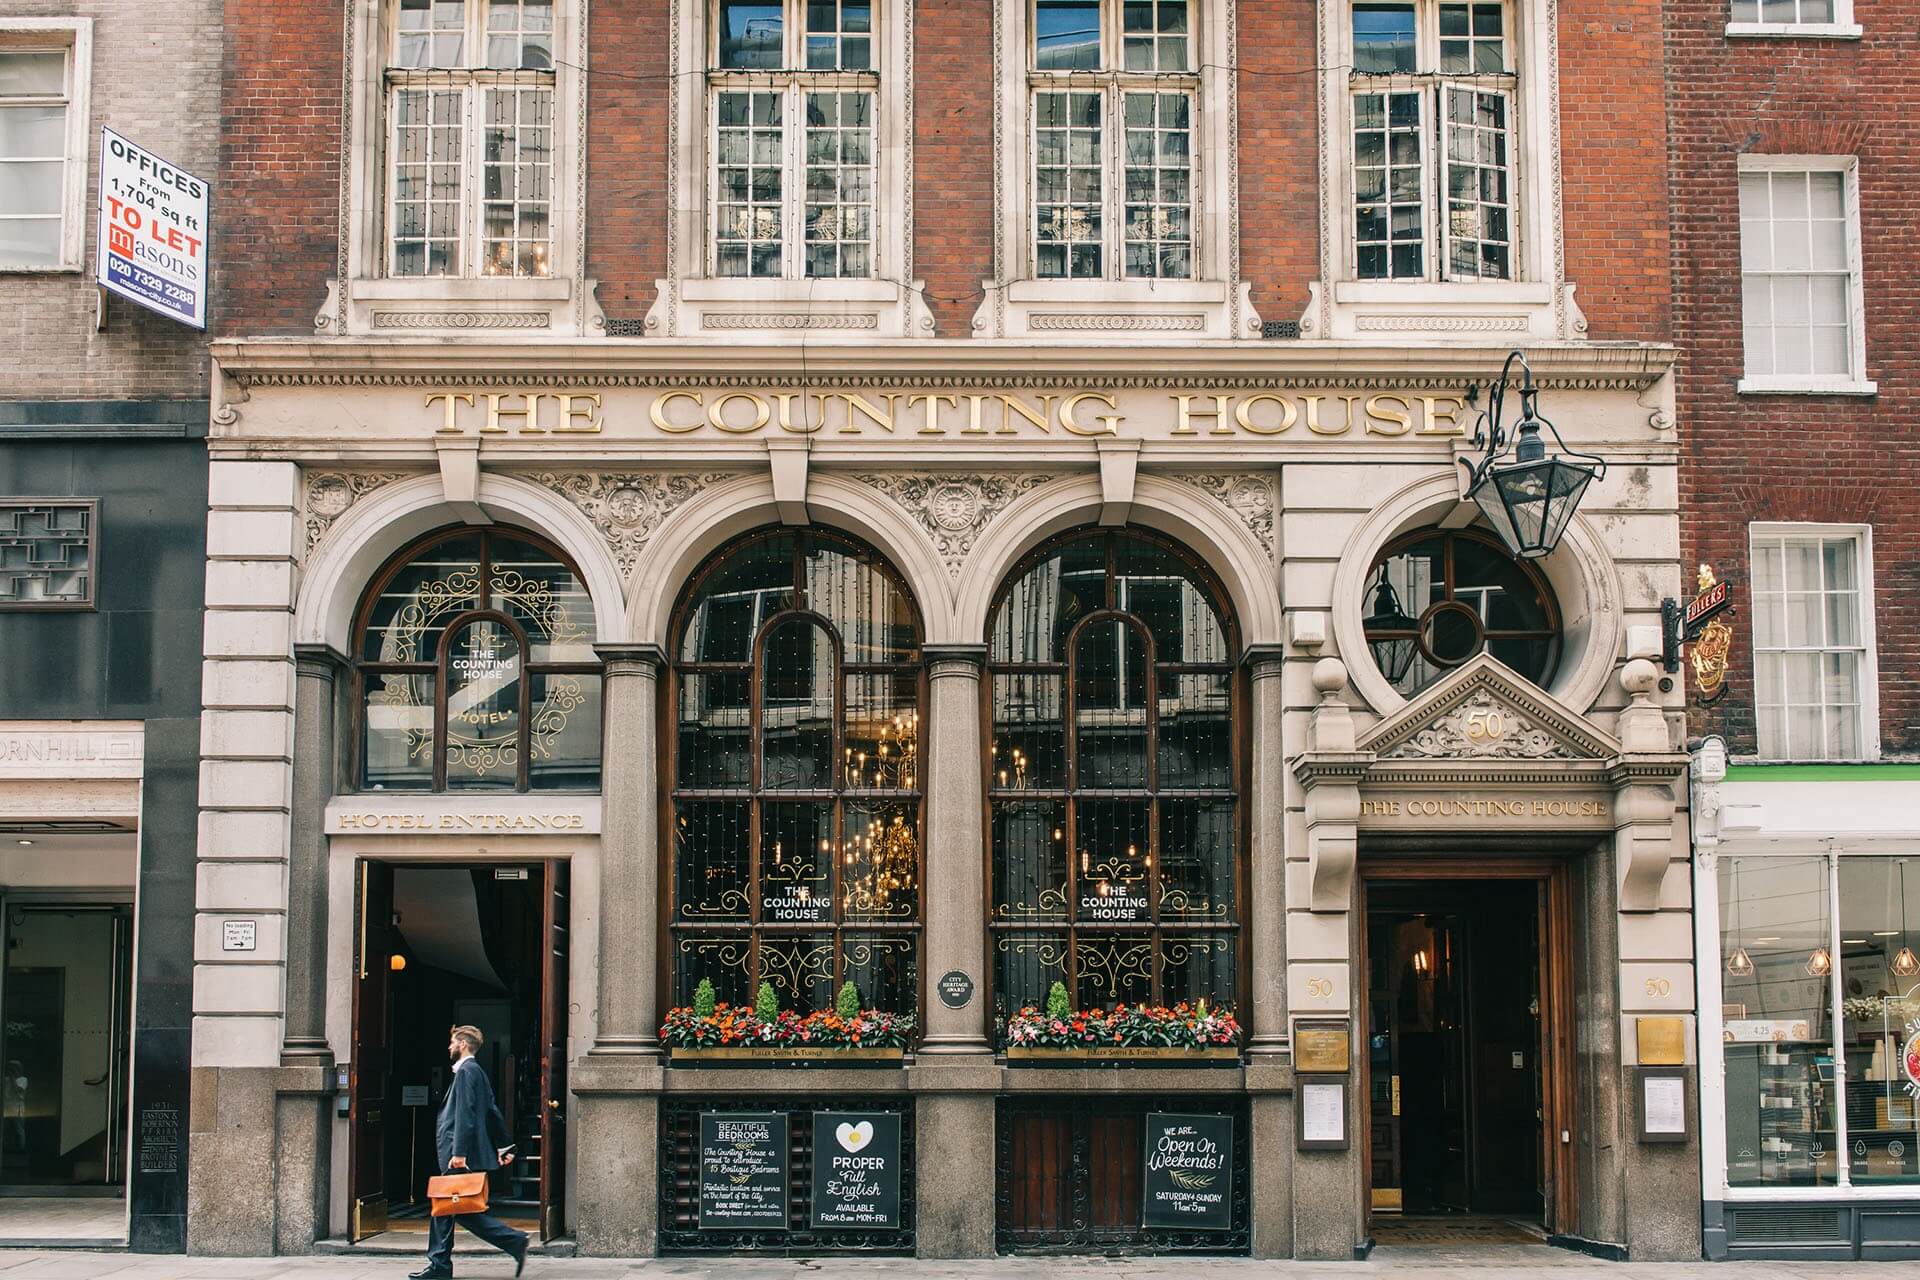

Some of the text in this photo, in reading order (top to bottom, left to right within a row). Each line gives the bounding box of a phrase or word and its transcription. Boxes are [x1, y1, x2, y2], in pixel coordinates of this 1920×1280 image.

[110, 139, 202, 199] OFFICES
[139, 178, 170, 201] From
[111, 178, 198, 231] 1,704 sq ft
[107, 196, 202, 258] TO LET
[109, 223, 197, 280] masons
[110, 257, 132, 277] 020
[134, 269, 162, 290] 7329
[165, 282, 194, 305] 2288
[425, 390, 1468, 437] THE COUNTING HOUSE
[472, 650, 494, 659] THE
[452, 660, 514, 669] COUNTING
[464, 670, 502, 679] HOUSE
[458, 711, 508, 724] HOTEL
[1465, 711, 1504, 741] 50
[1360, 799, 1608, 817] THE COUNTING HOUSE
[339, 813, 586, 830] HOTEL ENTRANCE
[784, 886, 810, 896] THE
[763, 898, 830, 908] COUNTING
[1082, 898, 1148, 908] COUNTING
[775, 909, 819, 919] HOUSE
[1093, 908, 1136, 919] HOUSE
[1308, 976, 1334, 998] 50
[1645, 978, 1672, 998] 50
[718, 1124, 768, 1132] BEAUTIFUL
[1164, 1127, 1176, 1135] WE
[718, 1132, 769, 1140] BEDROOMS
[1158, 1136, 1217, 1155] Open On
[704, 1157, 722, 1165] proud
[833, 1157, 885, 1170] PROPER
[721, 1164, 749, 1175] Boutique
[750, 1165, 780, 1174] Bedrooms
[840, 1170, 866, 1182] Full
[826, 1180, 881, 1201] English
[1156, 1192, 1191, 1200] SATURDAY
[1196, 1193, 1222, 1203] SUNDAY
[836, 1204, 875, 1212] AVAILABLE
[856, 1214, 887, 1222] MON-FRI
